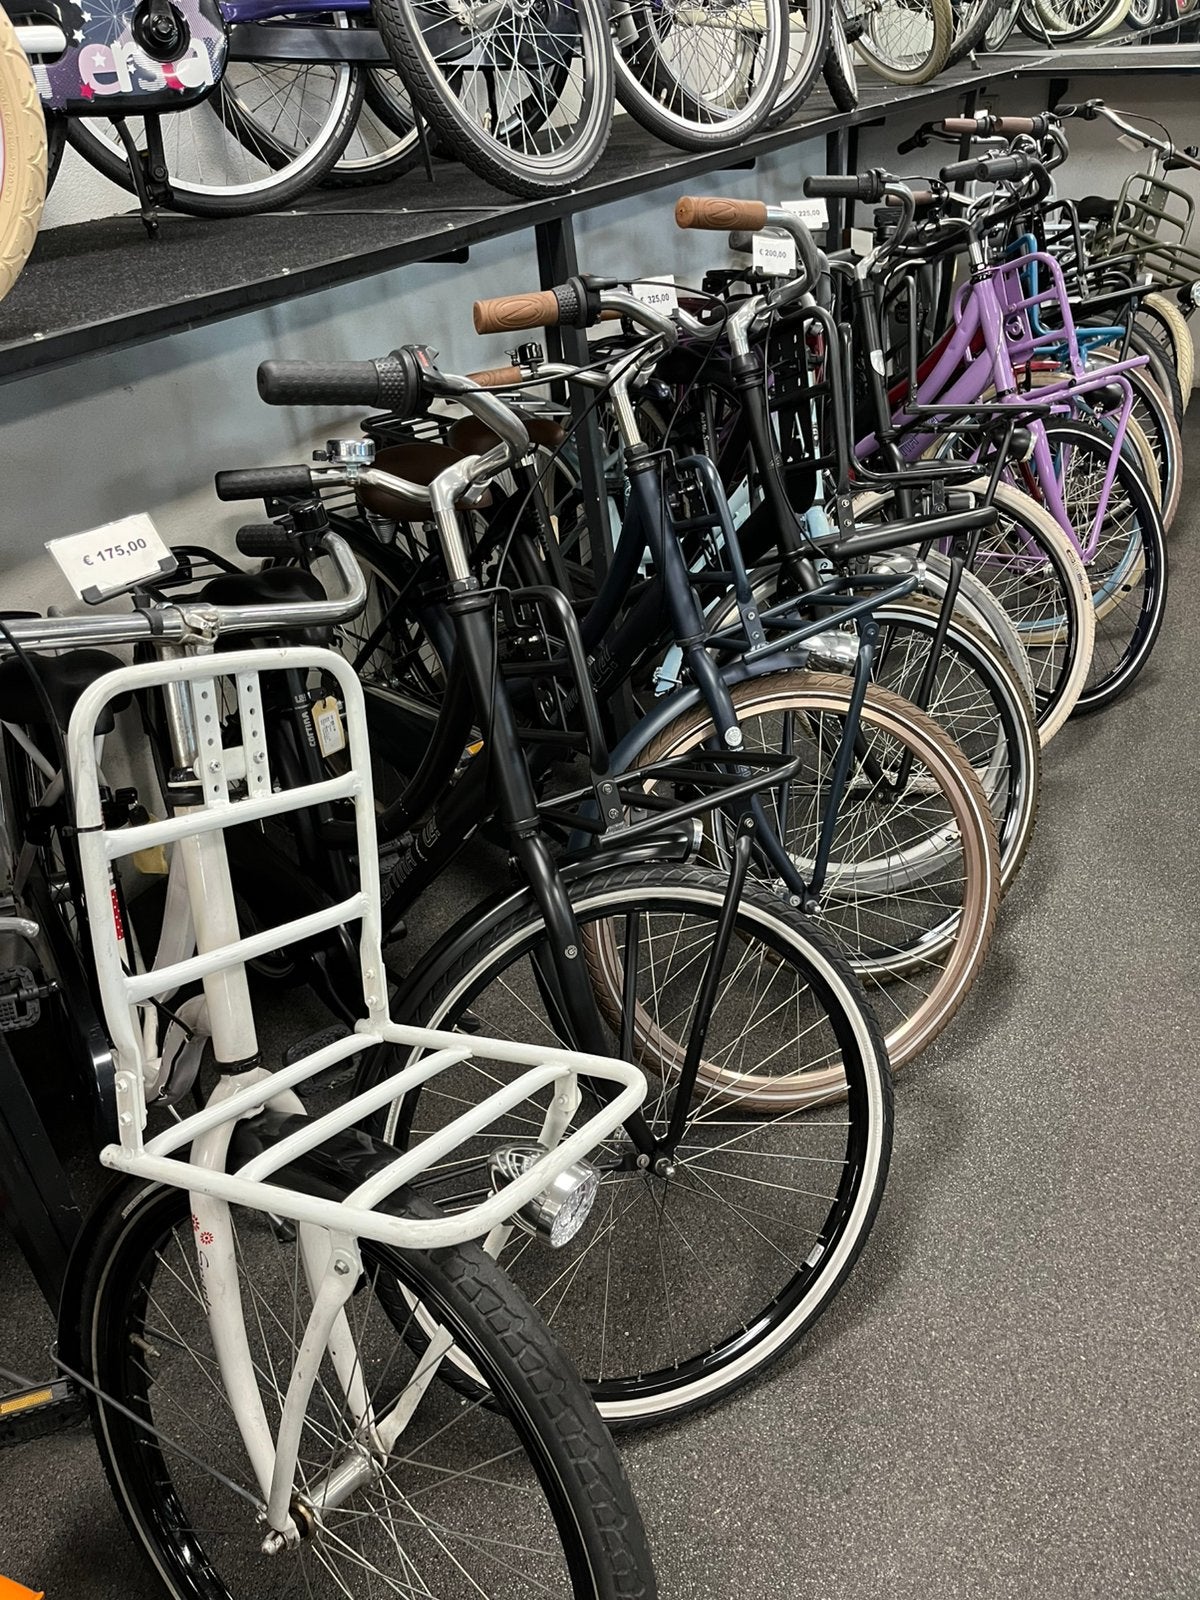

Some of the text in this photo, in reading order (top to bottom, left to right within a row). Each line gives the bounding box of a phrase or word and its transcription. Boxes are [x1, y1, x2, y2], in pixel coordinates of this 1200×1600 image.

[799, 209, 820, 217] 225,00
[764, 248, 787, 259] 200,00
[647, 293, 670, 304] 325,00
[82, 538, 147, 566] € 175,00
